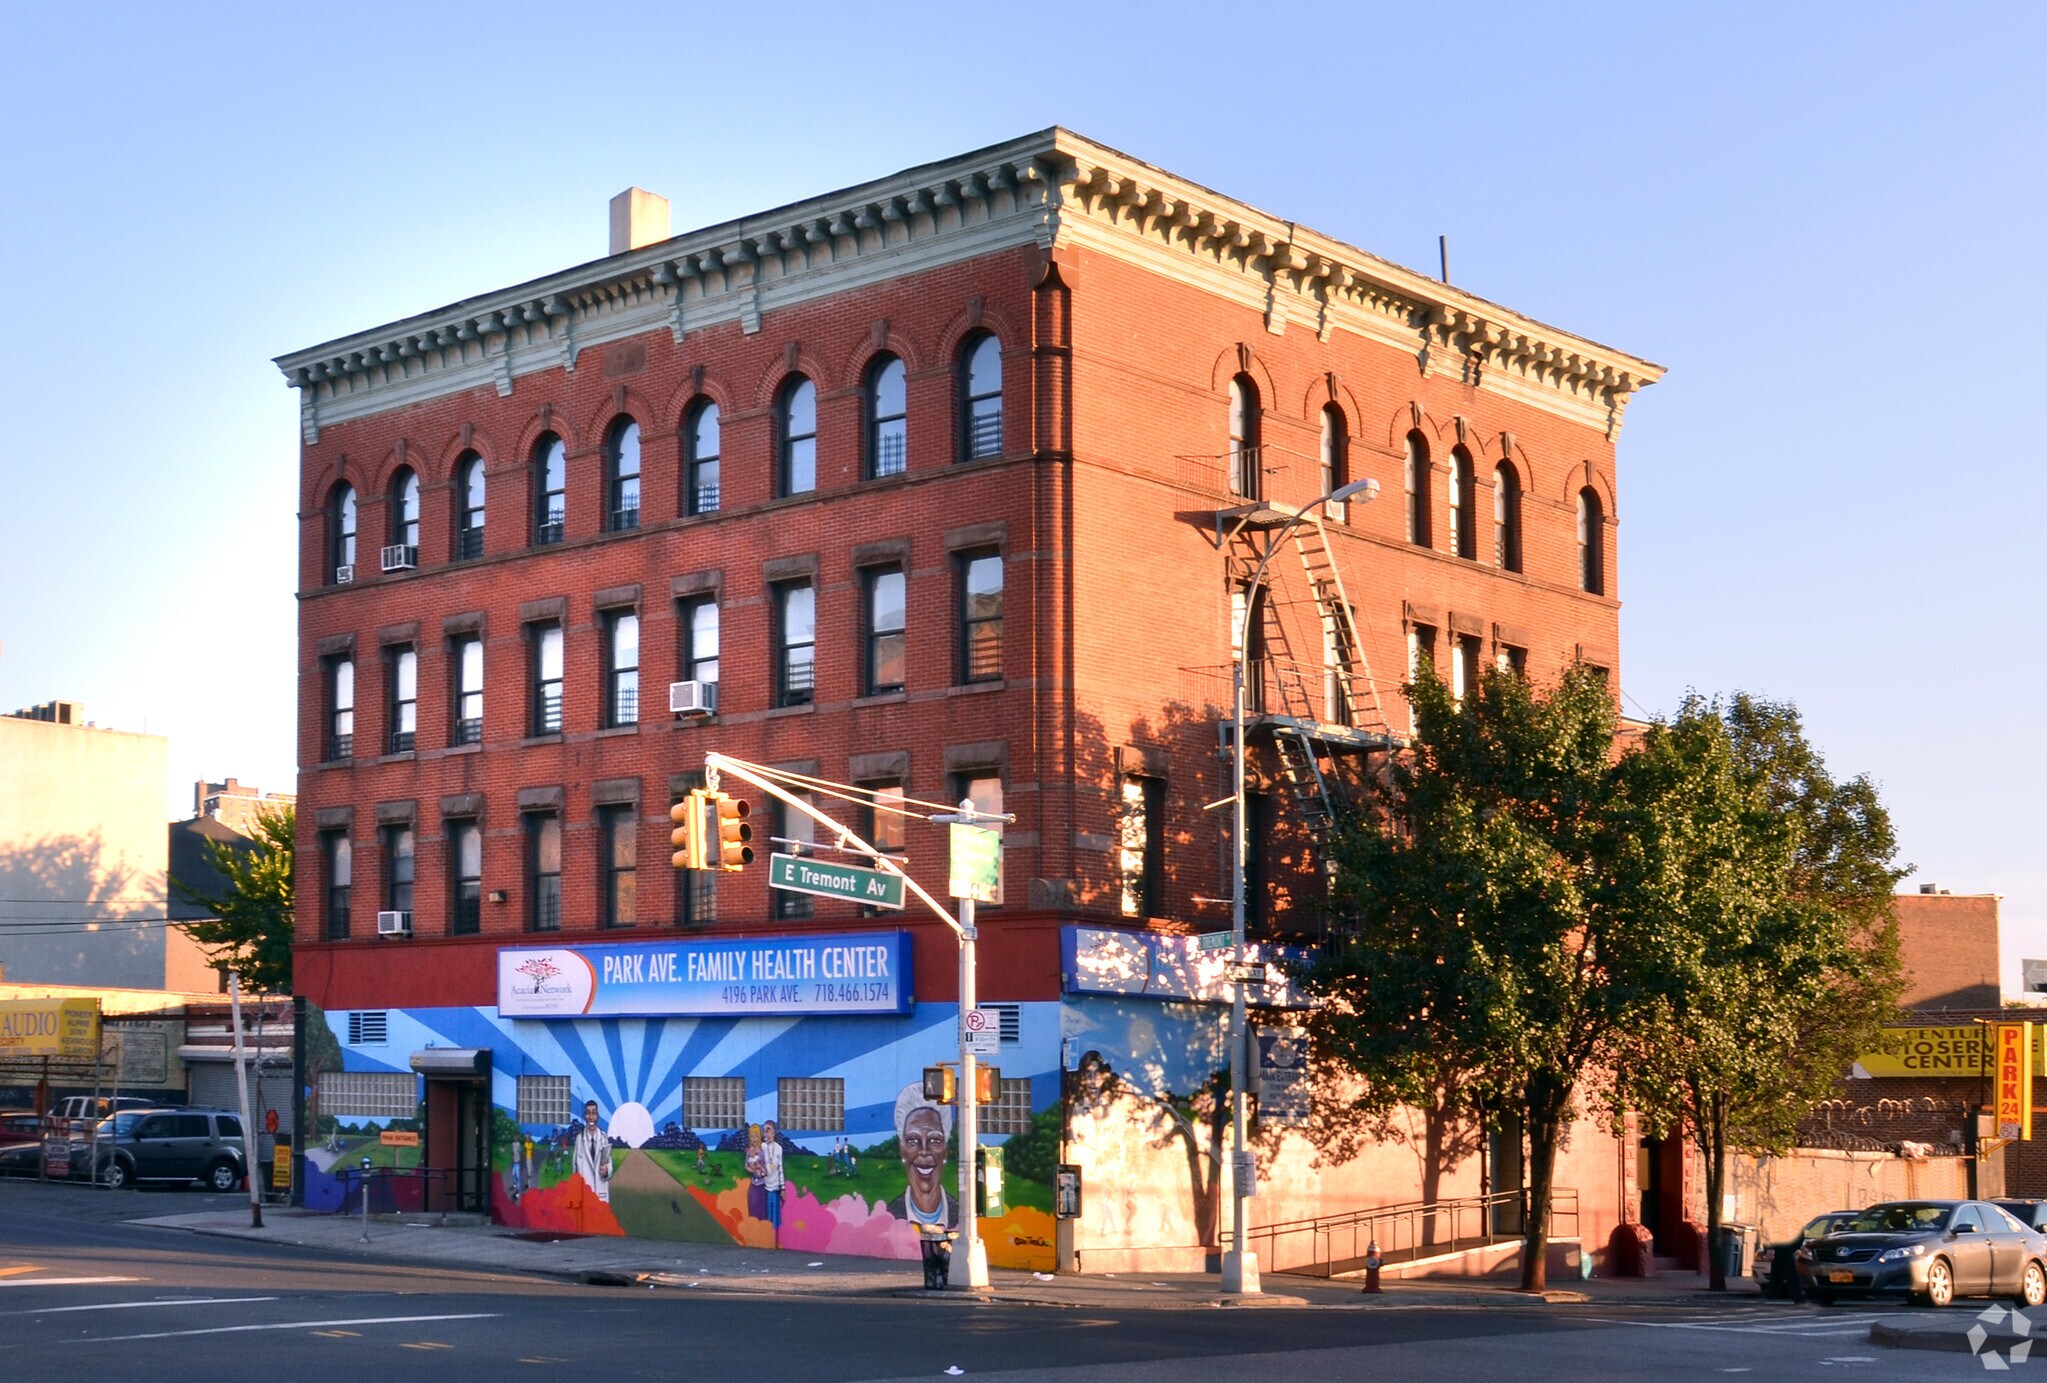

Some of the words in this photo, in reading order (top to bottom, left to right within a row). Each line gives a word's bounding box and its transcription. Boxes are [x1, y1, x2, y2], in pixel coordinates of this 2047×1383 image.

[785, 864, 794, 881] E
[800, 866, 856, 892] Tremont
[866, 878, 886, 896] Av
[604, 953, 644, 984] PARK
[648, 952, 682, 982] AVE.
[688, 950, 746, 981] FAMILY
[751, 948, 815, 980] HEALTH
[821, 945, 889, 979] CENTER
[541, 982, 572, 994] Network
[722, 986, 747, 1004] 4196
[750, 985, 777, 1003] PARK
[781, 985, 802, 1002] AVE.
[815, 982, 889, 1002] 718.466.1574
[2, 1011, 58, 1037] AUDIO
[1904, 1054, 1994, 1069] CENTER
[2003, 1029, 2018, 1099] PARK
[2001, 1102, 2019, 1115] 24
